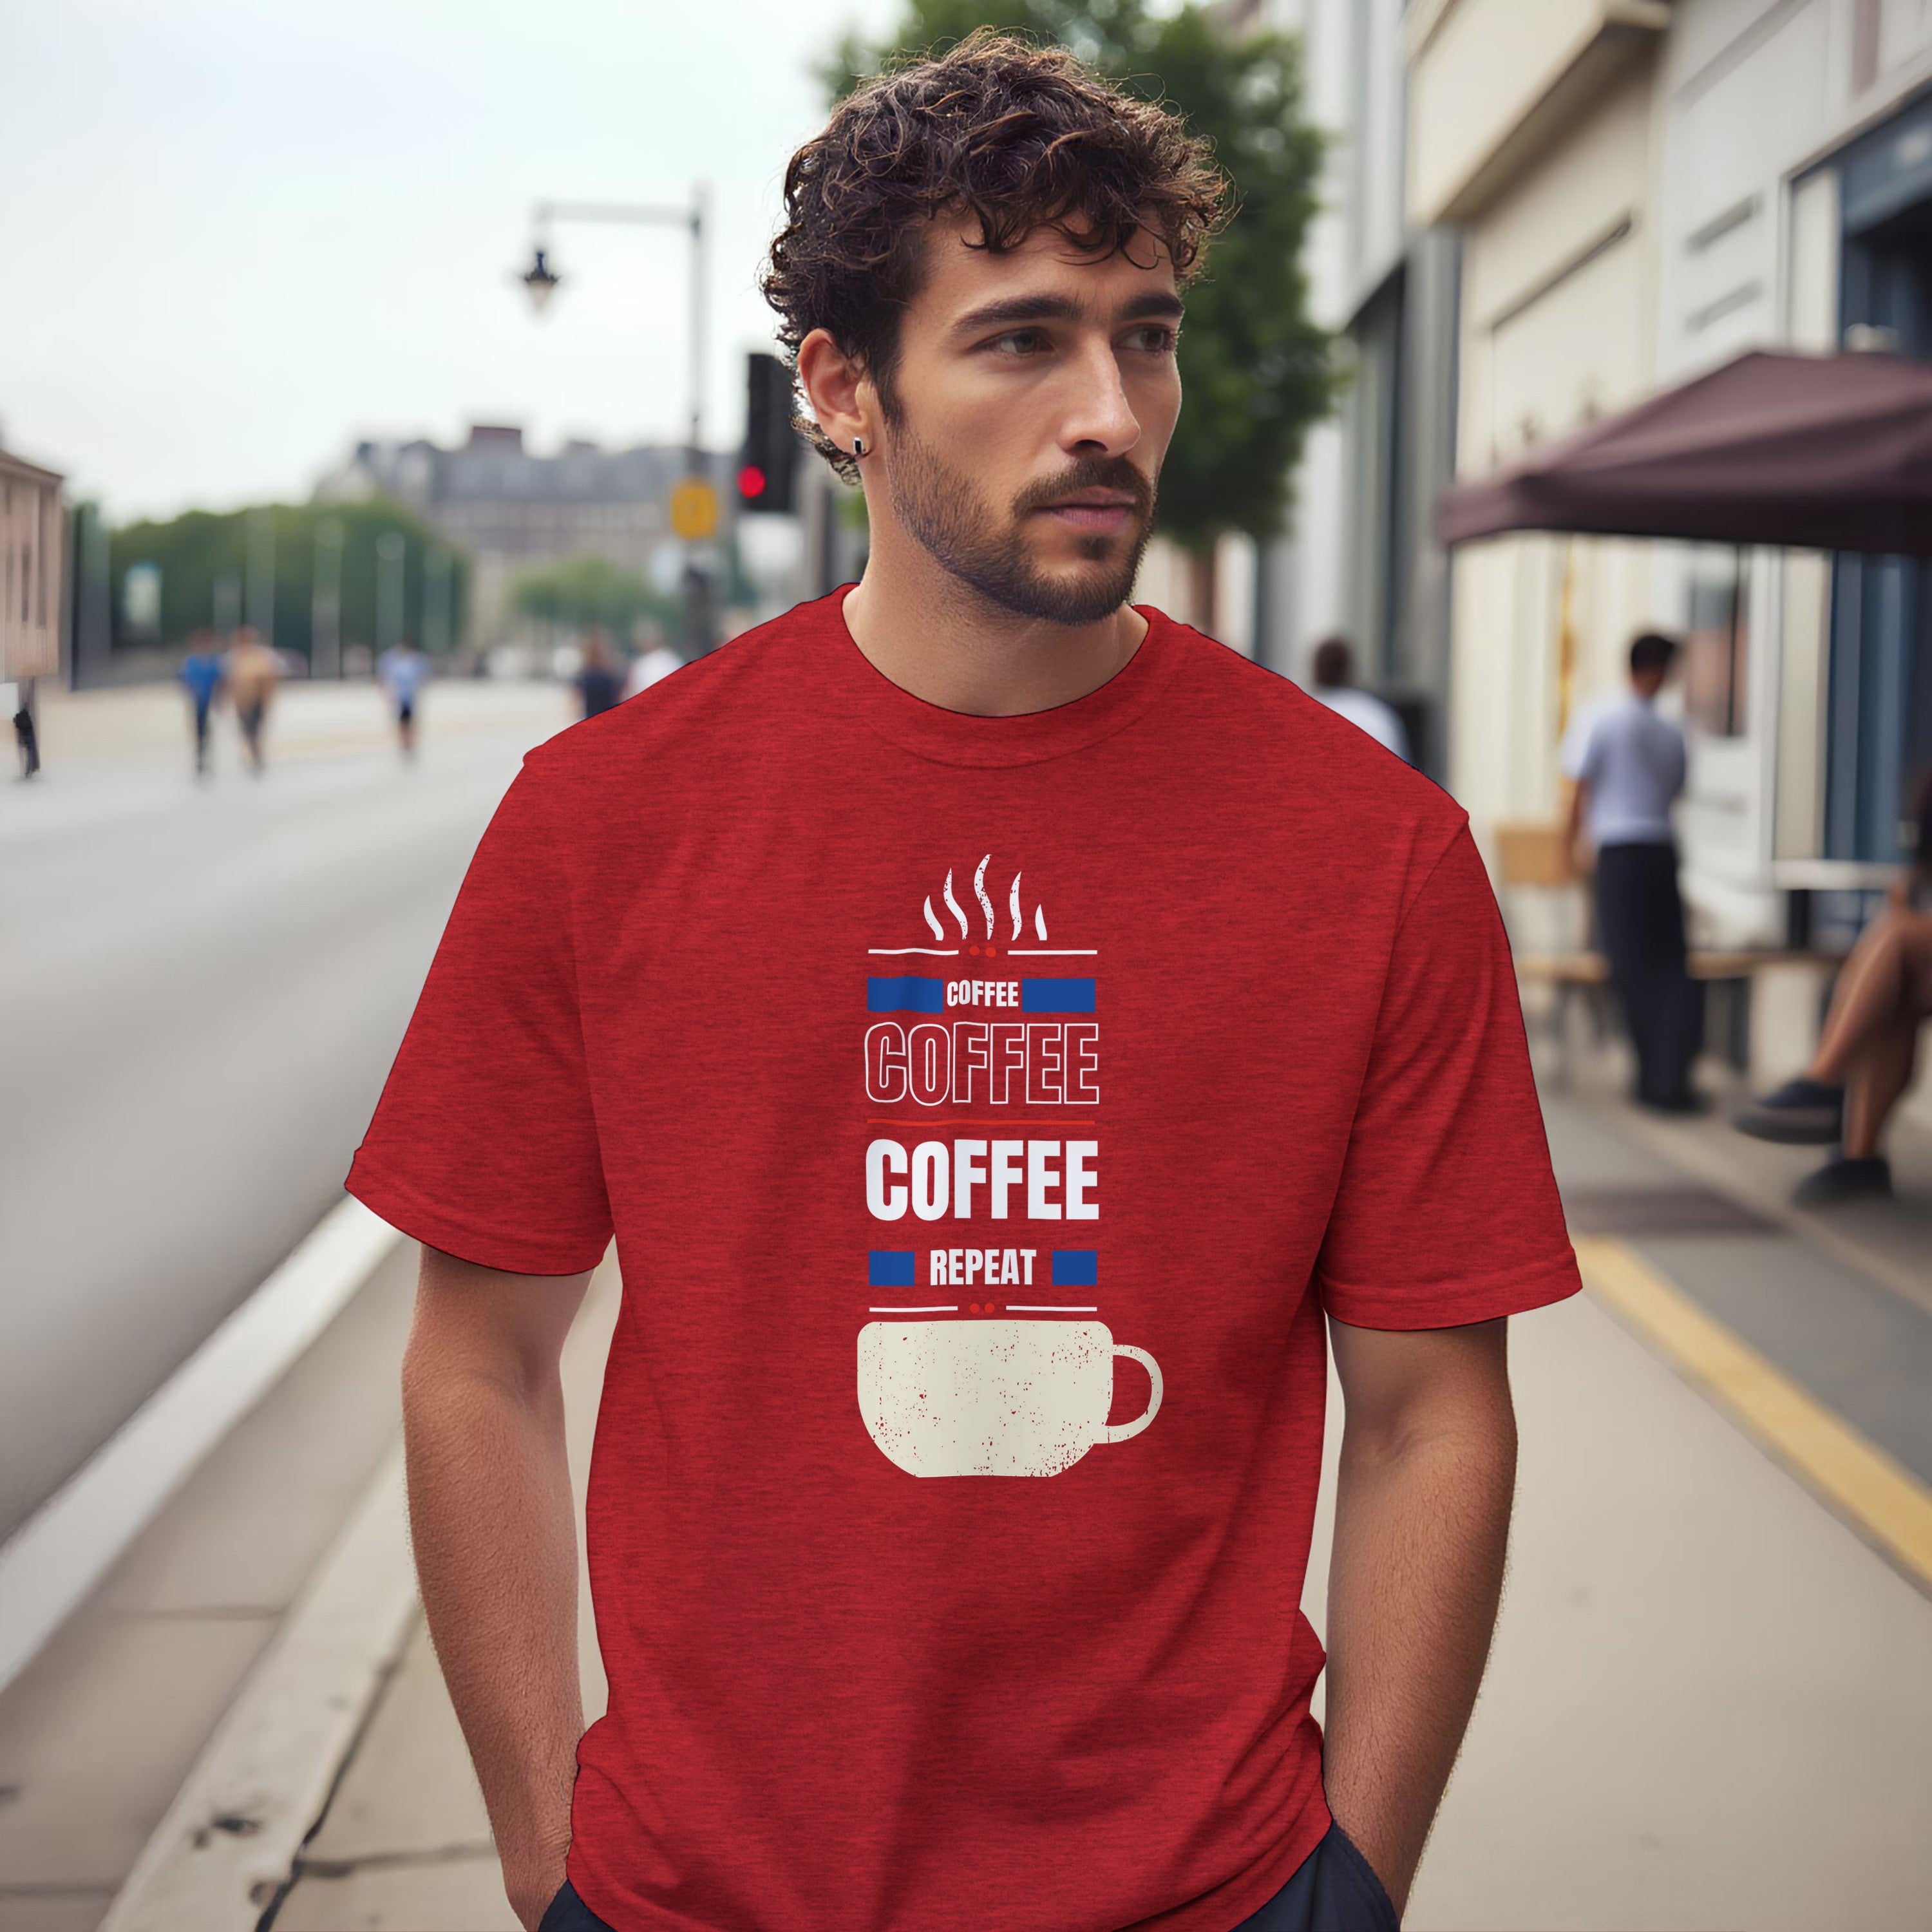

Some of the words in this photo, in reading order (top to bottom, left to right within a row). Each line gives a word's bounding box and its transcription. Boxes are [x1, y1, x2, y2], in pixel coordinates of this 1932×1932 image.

[947, 980, 1019, 1007] COFFEE
[864, 1021, 1100, 1106] COFFEE
[866, 1139, 1099, 1221] COFFEE
[929, 1249, 1037, 1286] REPEAT
